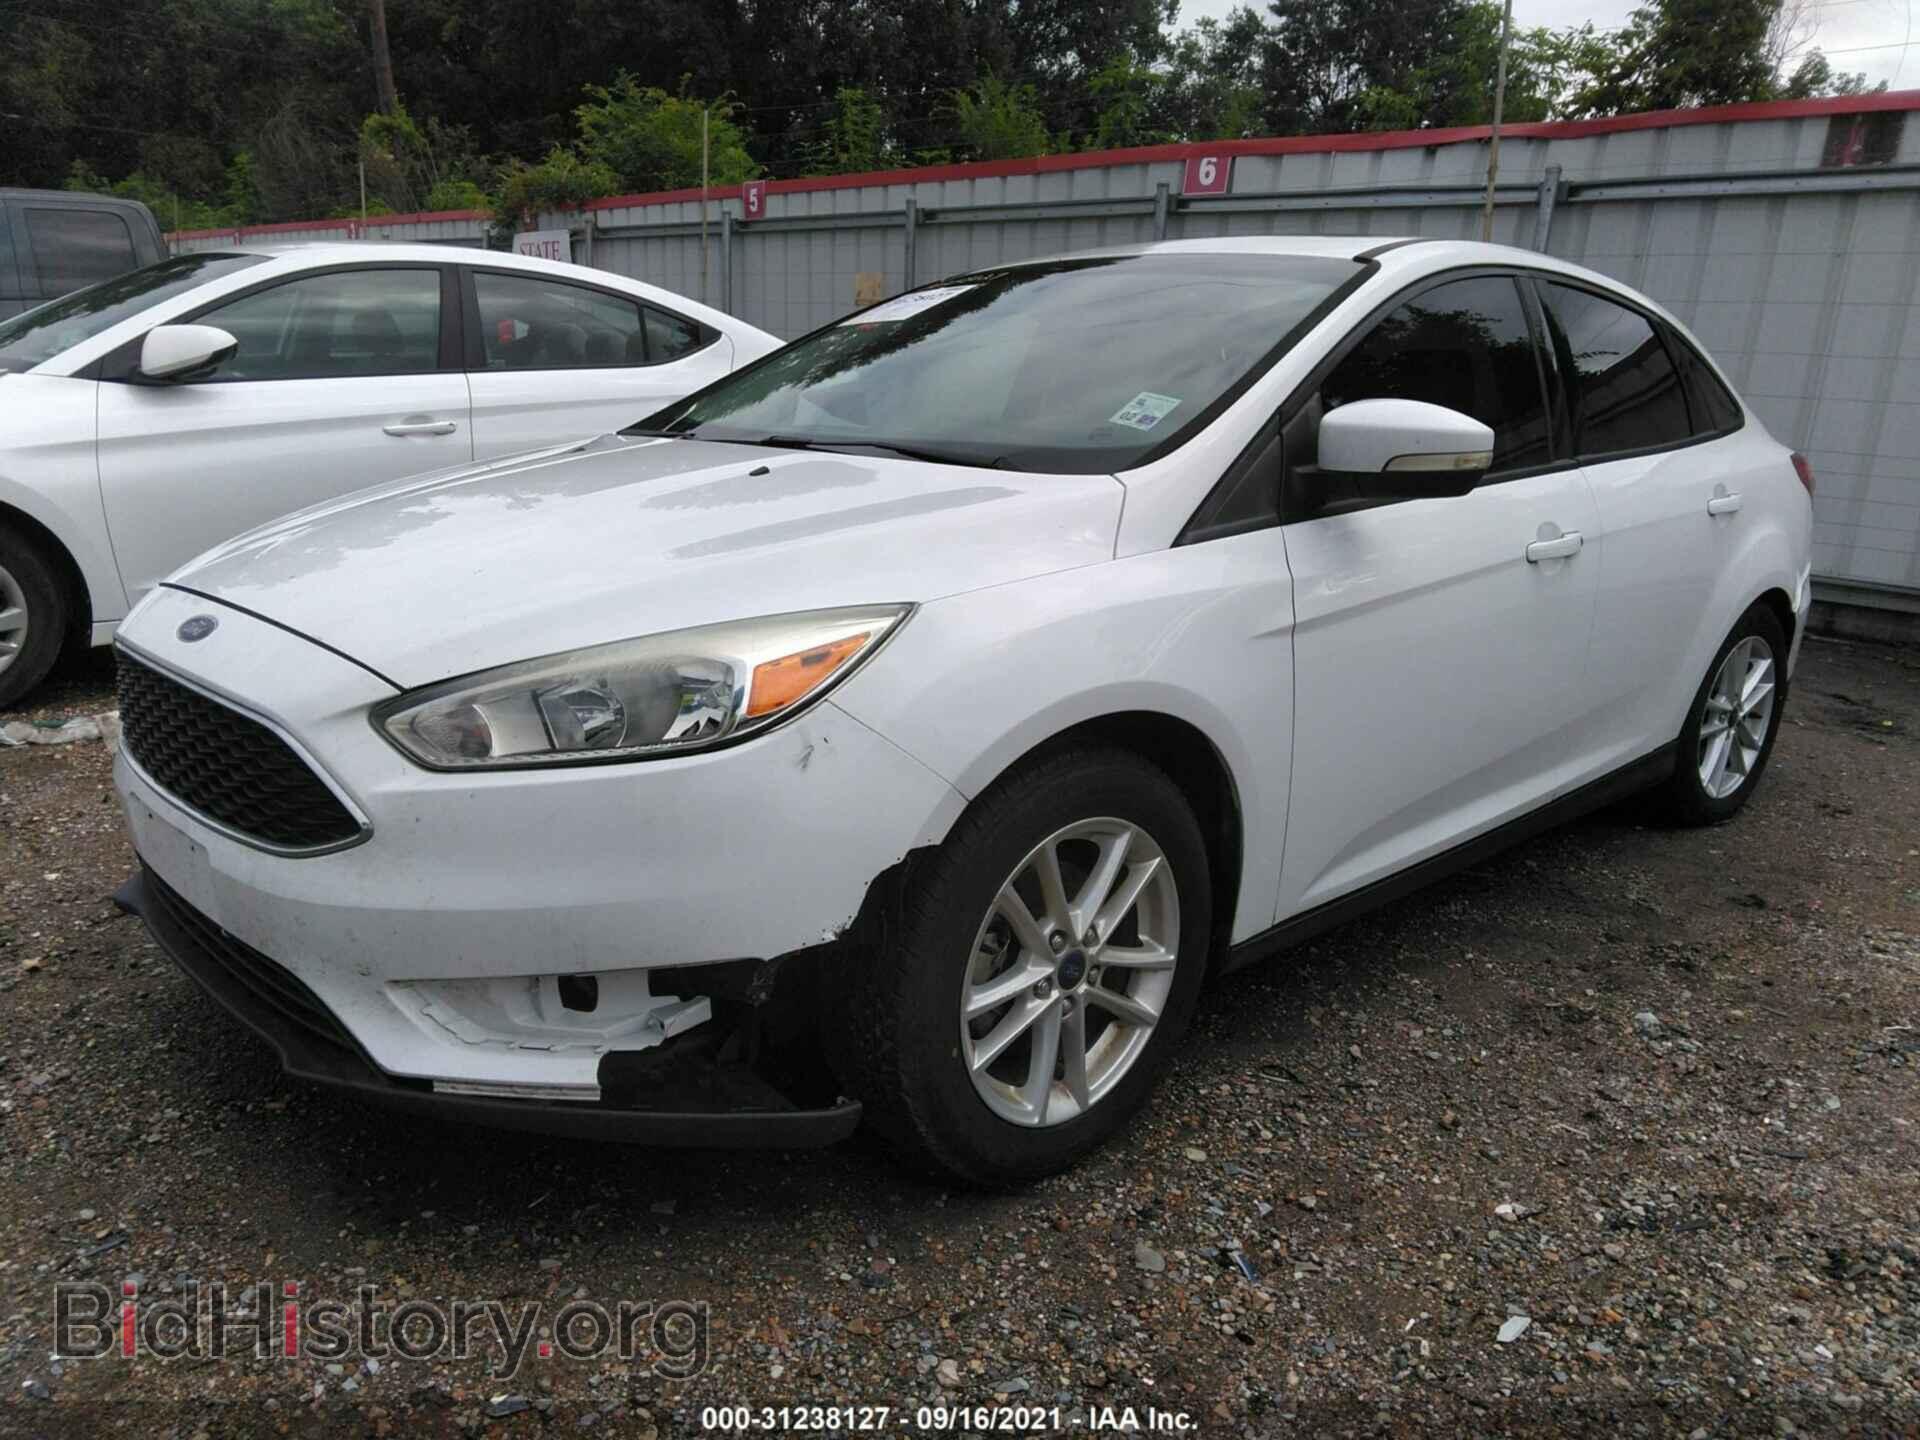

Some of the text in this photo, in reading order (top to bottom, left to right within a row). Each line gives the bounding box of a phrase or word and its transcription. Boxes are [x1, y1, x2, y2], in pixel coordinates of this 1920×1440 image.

[1199, 157, 1217, 186] 6
[749, 188, 759, 212] 5
[520, 240, 561, 261] STATE
